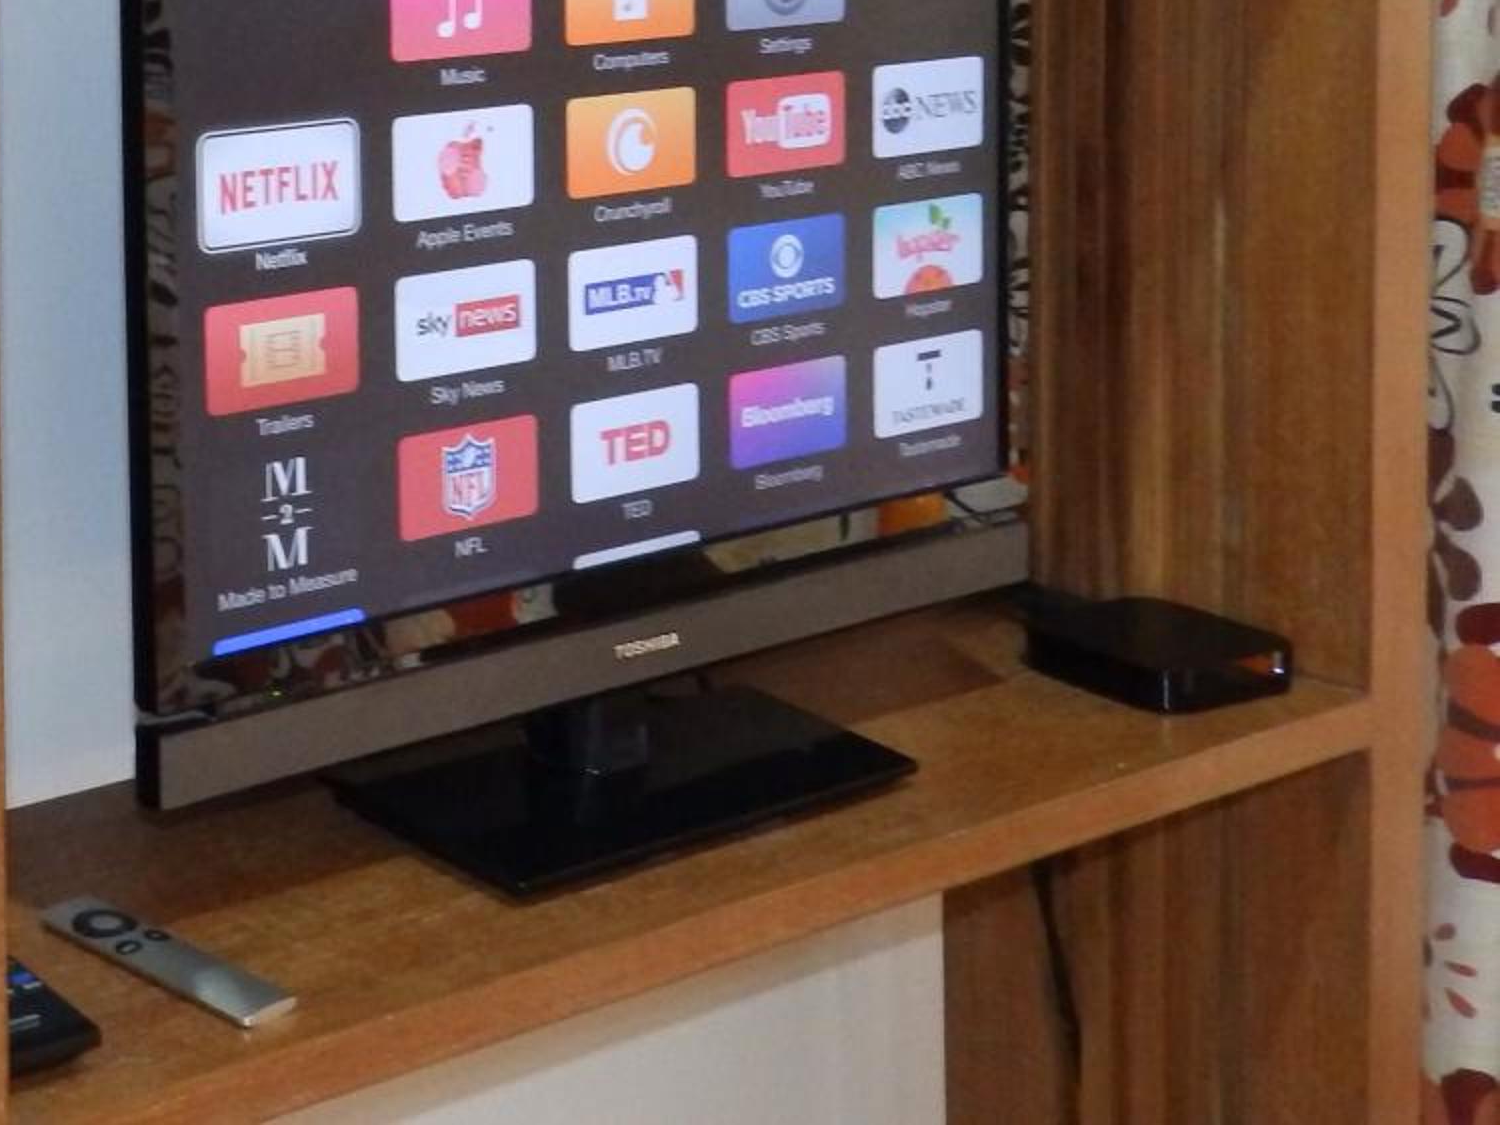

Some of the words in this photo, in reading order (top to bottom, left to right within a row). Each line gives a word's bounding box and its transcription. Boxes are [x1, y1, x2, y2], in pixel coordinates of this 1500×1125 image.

[592, 49, 669, 72] Computers
[440, 67, 488, 86] Music
[915, 89, 979, 119] NEWS
[741, 99, 828, 145] YouTube
[219, 161, 339, 215] NETFLIX
[416, 227, 460, 250] Apple
[462, 219, 514, 242] Events
[255, 249, 309, 271] Netflix
[736, 287, 771, 309] CBS
[771, 276, 836, 302] SPORTS
[416, 309, 452, 338] sky
[458, 300, 519, 329] news
[430, 384, 460, 406] Sky
[462, 379, 505, 400] News
[255, 413, 316, 436] Trailers
[740, 394, 835, 429] Bloomberg
[600, 419, 672, 466] TED
[261, 456, 313, 502] M
[622, 499, 654, 521] TED
[261, 526, 315, 572] M
[455, 536, 488, 558] NFL
[217, 584, 266, 612] Made
[267, 580, 287, 600] to
[289, 567, 358, 596] Measure
[614, 632, 680, 660] TOSHIBA
